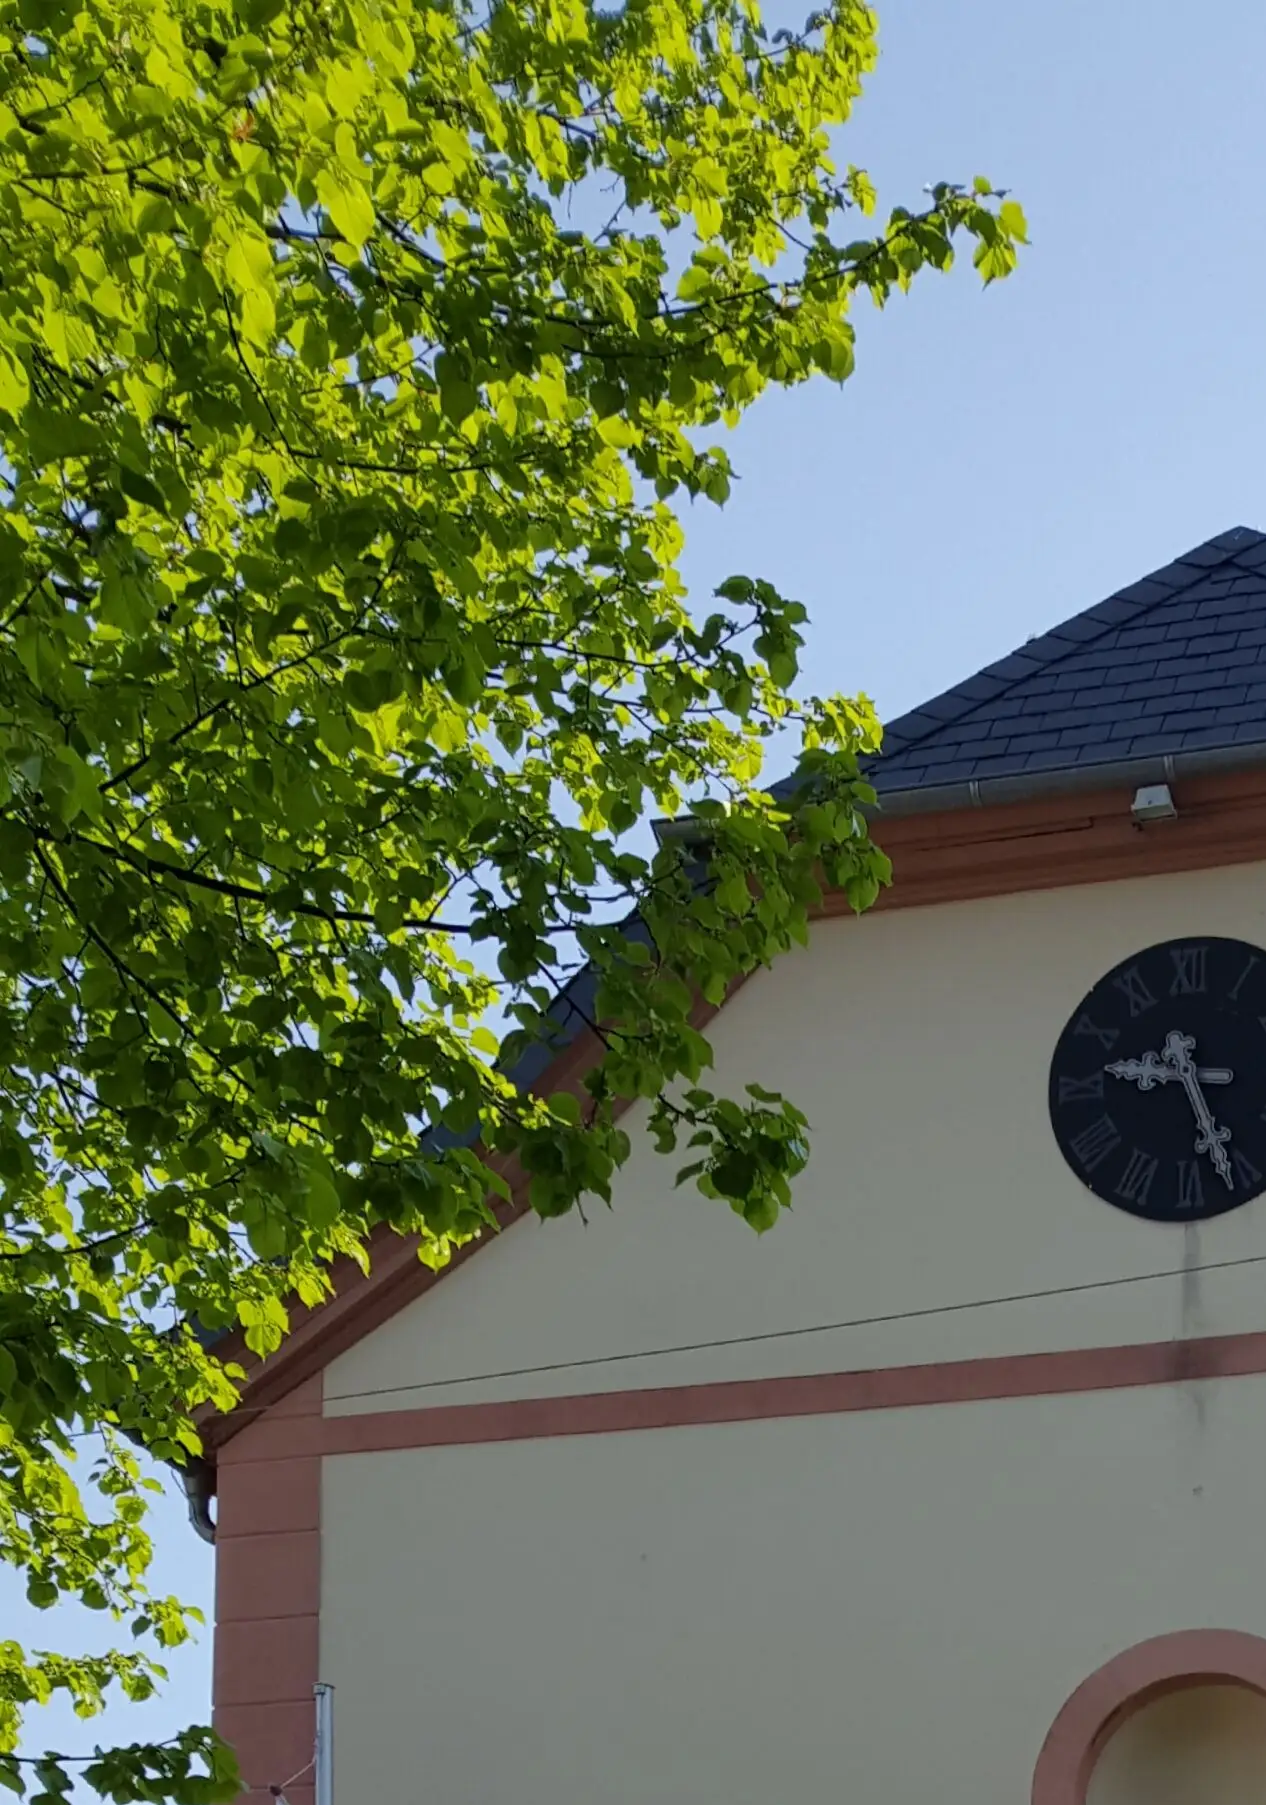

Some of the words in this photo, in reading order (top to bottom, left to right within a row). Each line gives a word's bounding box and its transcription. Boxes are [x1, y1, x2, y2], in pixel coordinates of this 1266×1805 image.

[1112, 966, 1159, 1017] XI
[1169, 946, 1208, 997] XII
[1229, 955, 1260, 1001] I
[1073, 1013, 1121, 1051] X
[1058, 1072, 1104, 1106] IX
[1069, 1113, 1122, 1173] VIII
[1114, 1148, 1159, 1206] VII
[1176, 1160, 1204, 1208] VI
[1232, 1149, 1263, 1190] V
